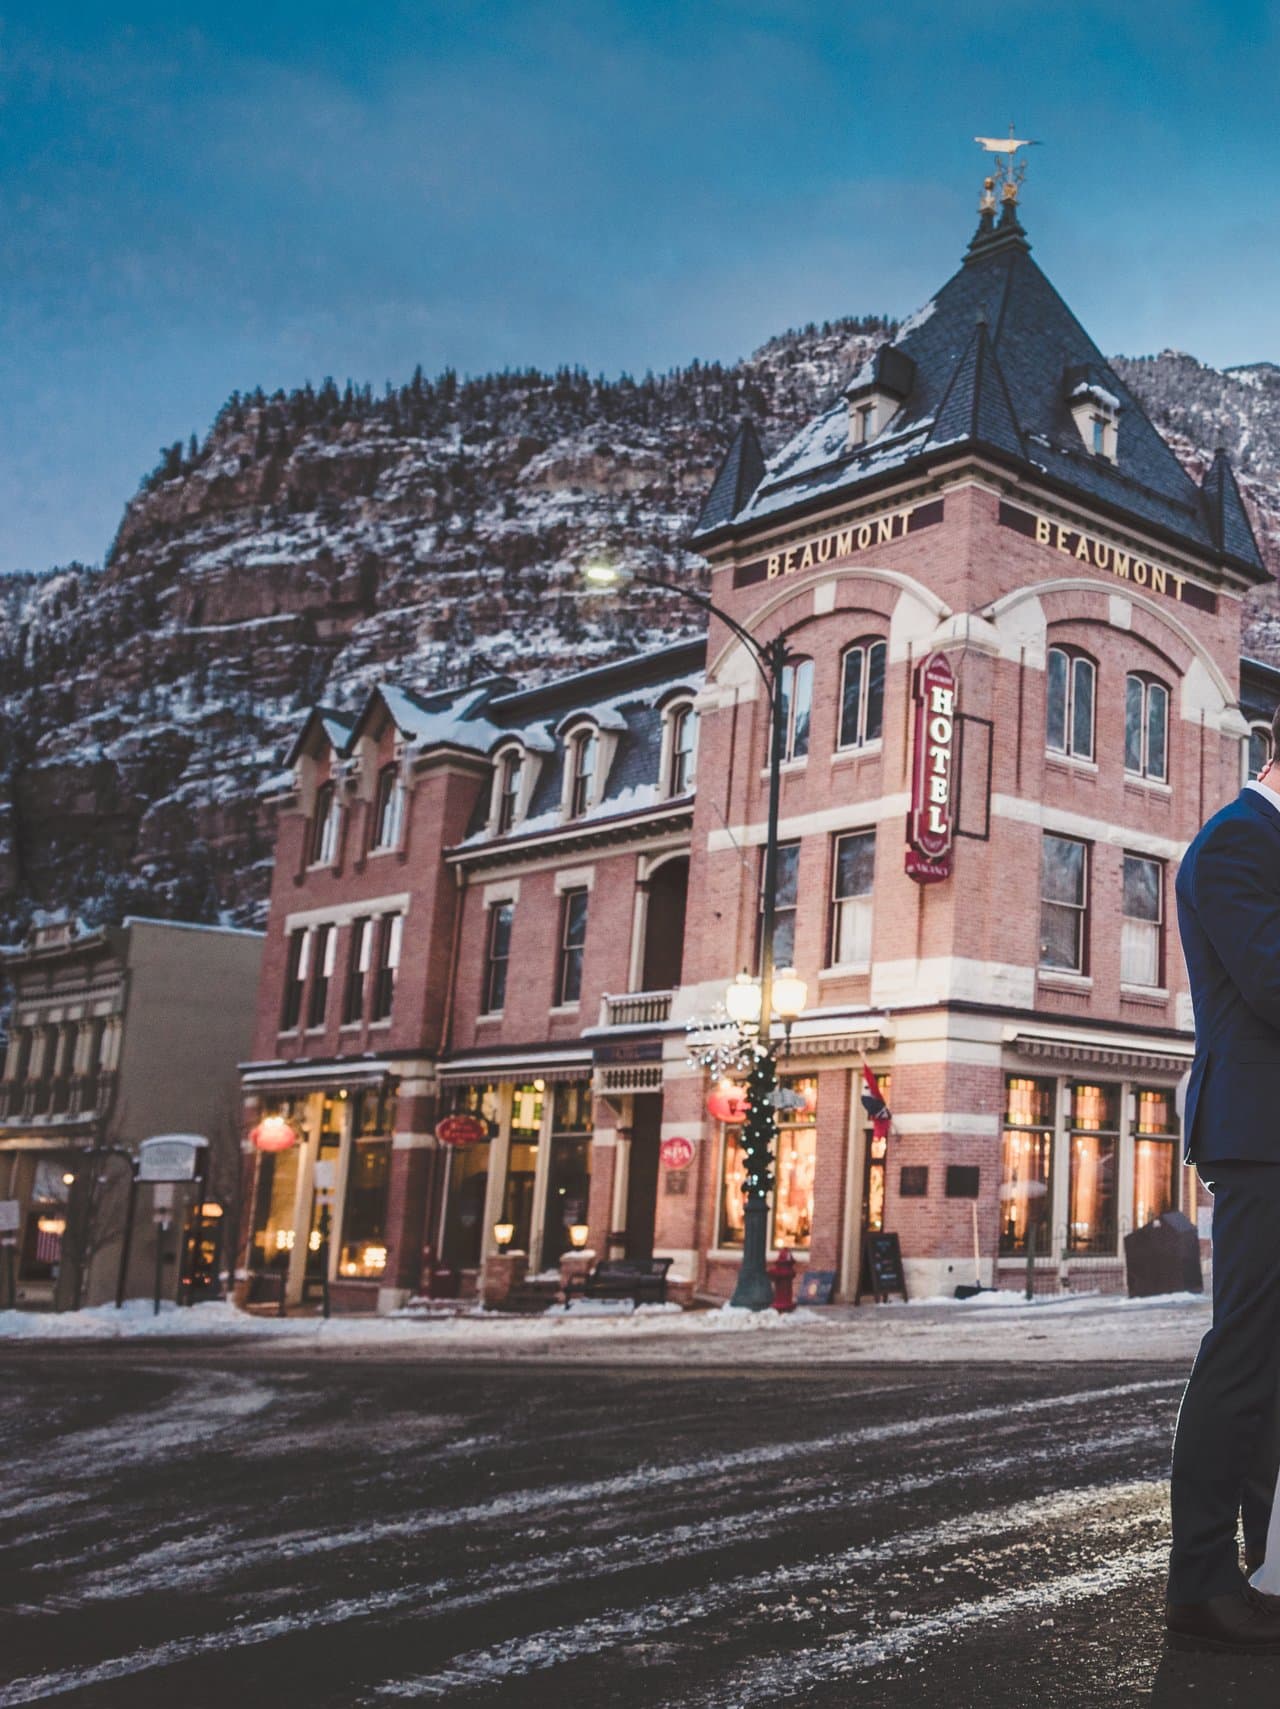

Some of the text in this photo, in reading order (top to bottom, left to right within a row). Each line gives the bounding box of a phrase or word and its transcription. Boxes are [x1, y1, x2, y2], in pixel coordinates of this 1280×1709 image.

[767, 510, 913, 580] BEAUMONT
[1035, 516, 1187, 601] BEAUMONT
[930, 686, 953, 834] HOTEL
